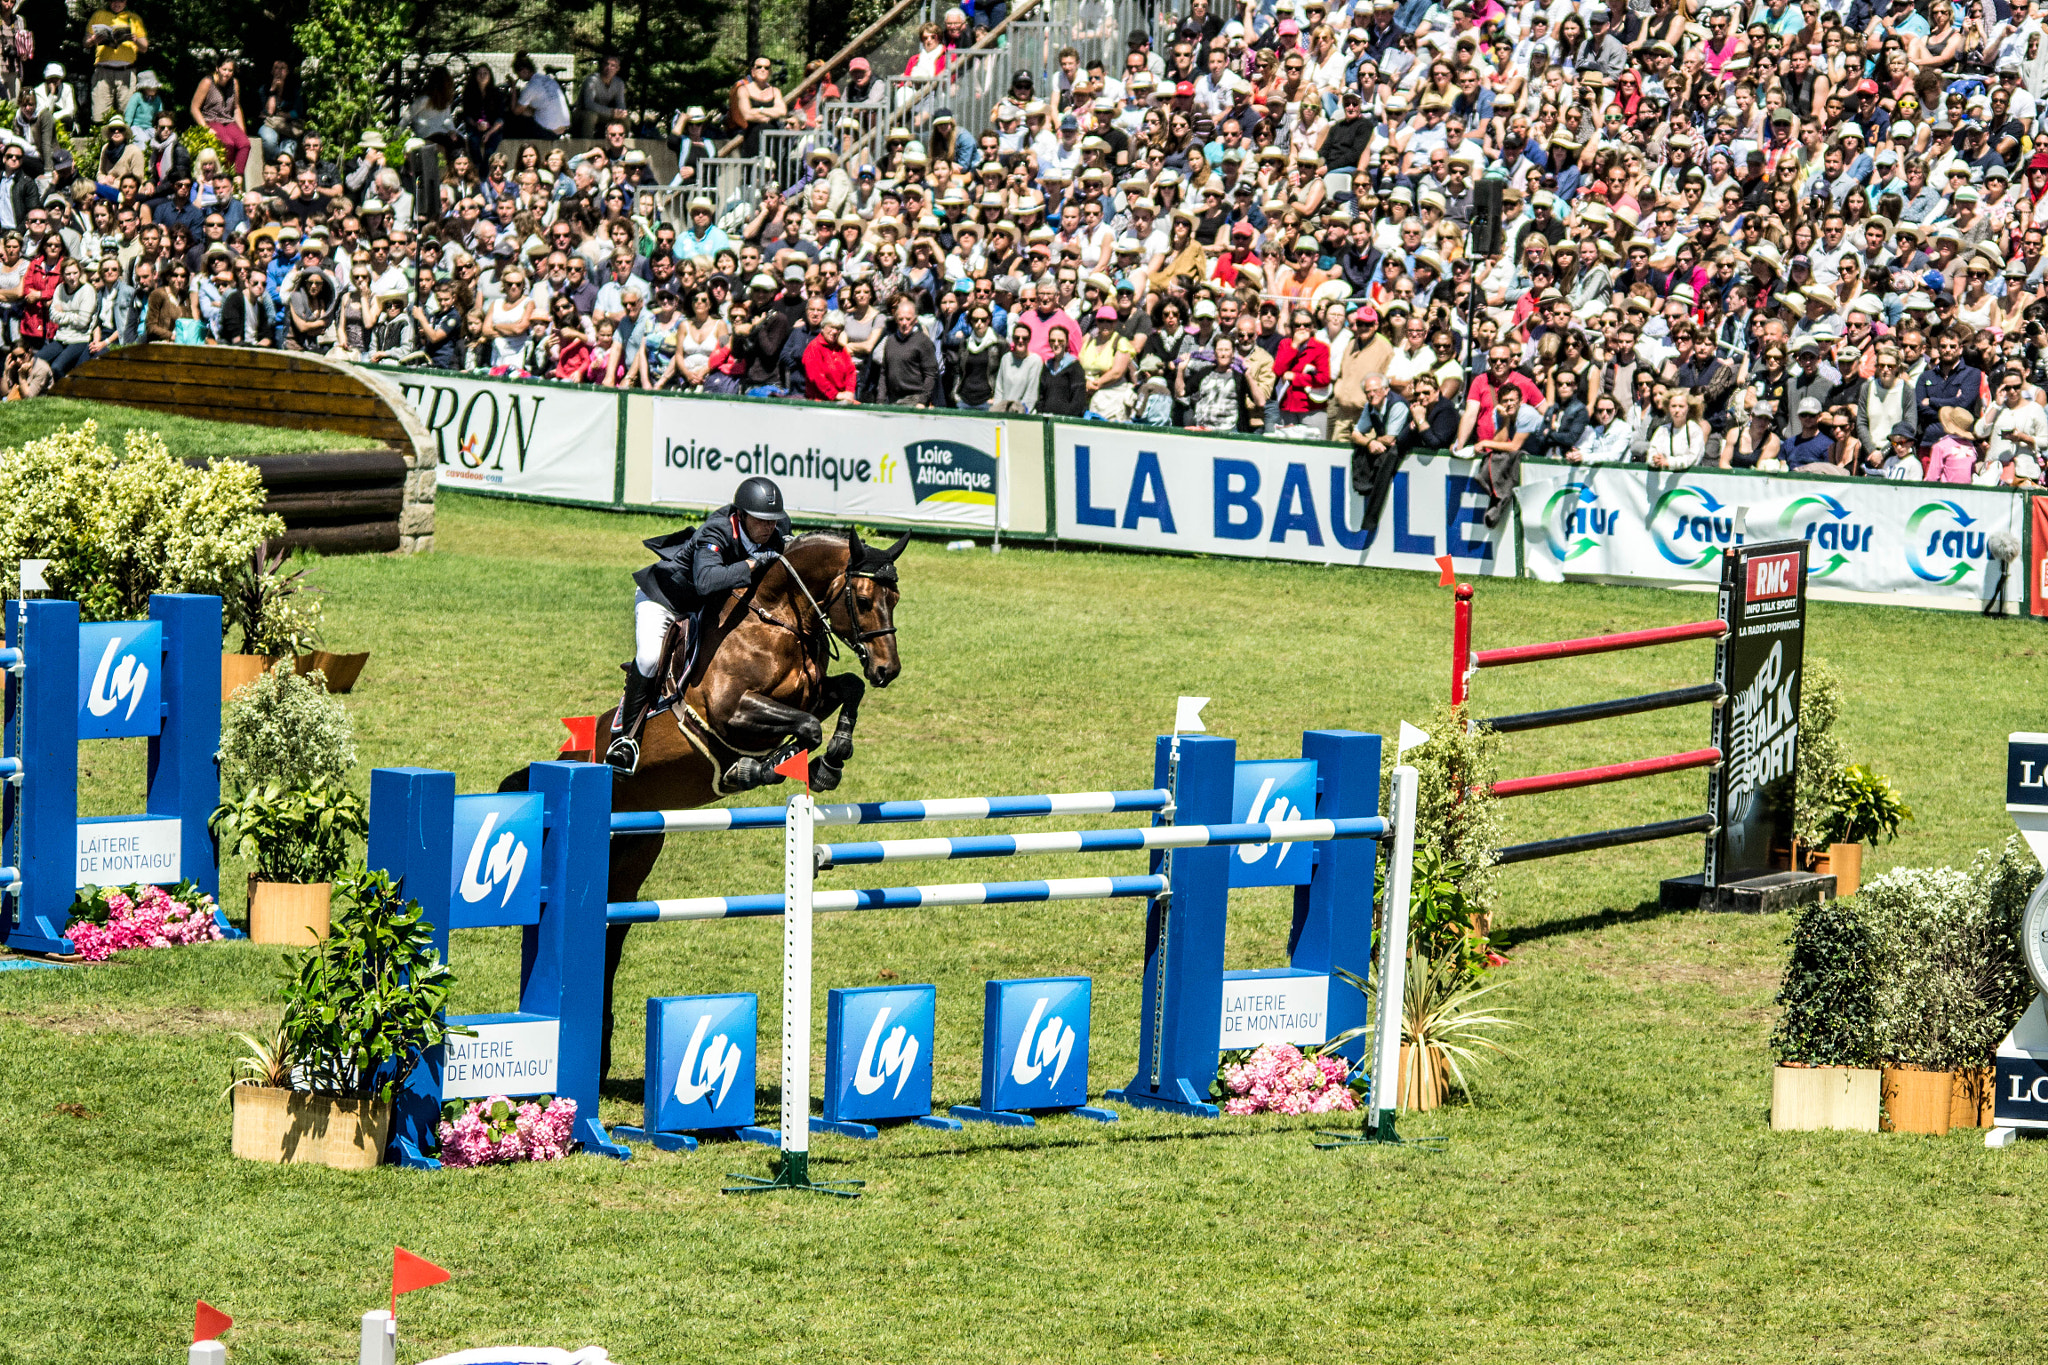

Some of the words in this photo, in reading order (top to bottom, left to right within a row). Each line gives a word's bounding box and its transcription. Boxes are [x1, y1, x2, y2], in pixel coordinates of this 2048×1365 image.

[665, 437, 897, 492] loire-atlantique.fr
[916, 444, 953, 465] Loire
[916, 464, 992, 492] Atlantique
[1074, 444, 1178, 535] LA
[1213, 457, 1494, 560] BAULE
[1805, 522, 1873, 552] saur
[1755, 558, 1791, 596] RMC
[1746, 603, 1760, 615] INFO
[1761, 601, 1776, 612] TALK
[1777, 598, 1797, 611] SPORT
[1739, 626, 1748, 637] LA
[1748, 624, 1766, 635] RADIO
[1767, 619, 1800, 633] D'OPINIONS
[1746, 640, 1783, 724] INFO
[1749, 670, 1796, 753] TALK
[1743, 723, 1798, 793] SPORT
[81, 836, 139, 855] LAITERIE
[80, 856, 98, 872] DE
[1226, 994, 1287, 1013] LAITERIE
[1225, 1016, 1243, 1032] DE
[449, 1041, 513, 1061] LAITERIE
[448, 1064, 467, 1081] DE
